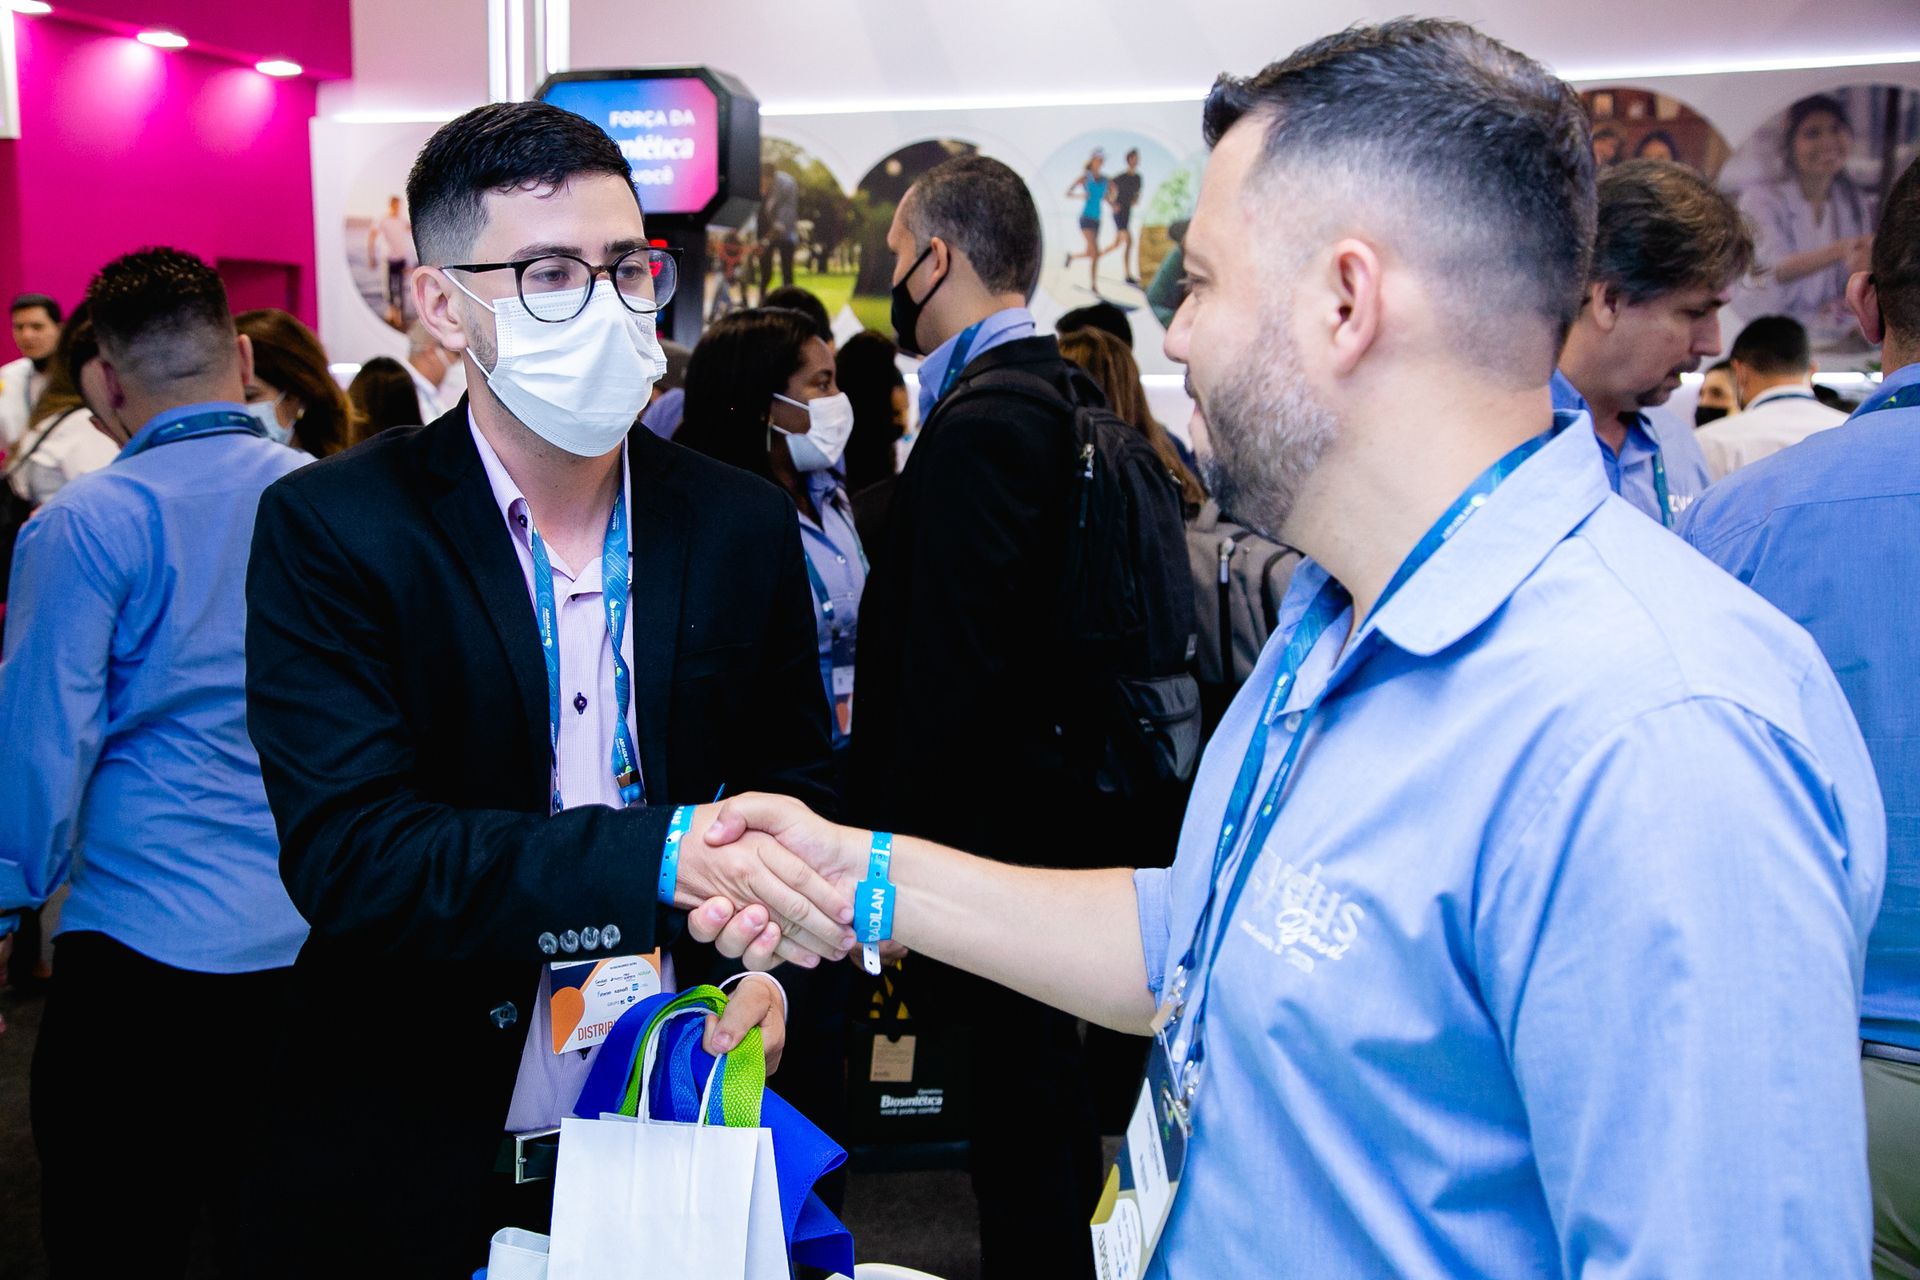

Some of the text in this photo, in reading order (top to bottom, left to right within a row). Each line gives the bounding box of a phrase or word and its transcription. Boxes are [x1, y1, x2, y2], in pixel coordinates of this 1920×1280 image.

[609, 109, 696, 129] FORÇA DA
[578, 1020, 616, 1041] DISTRIB
